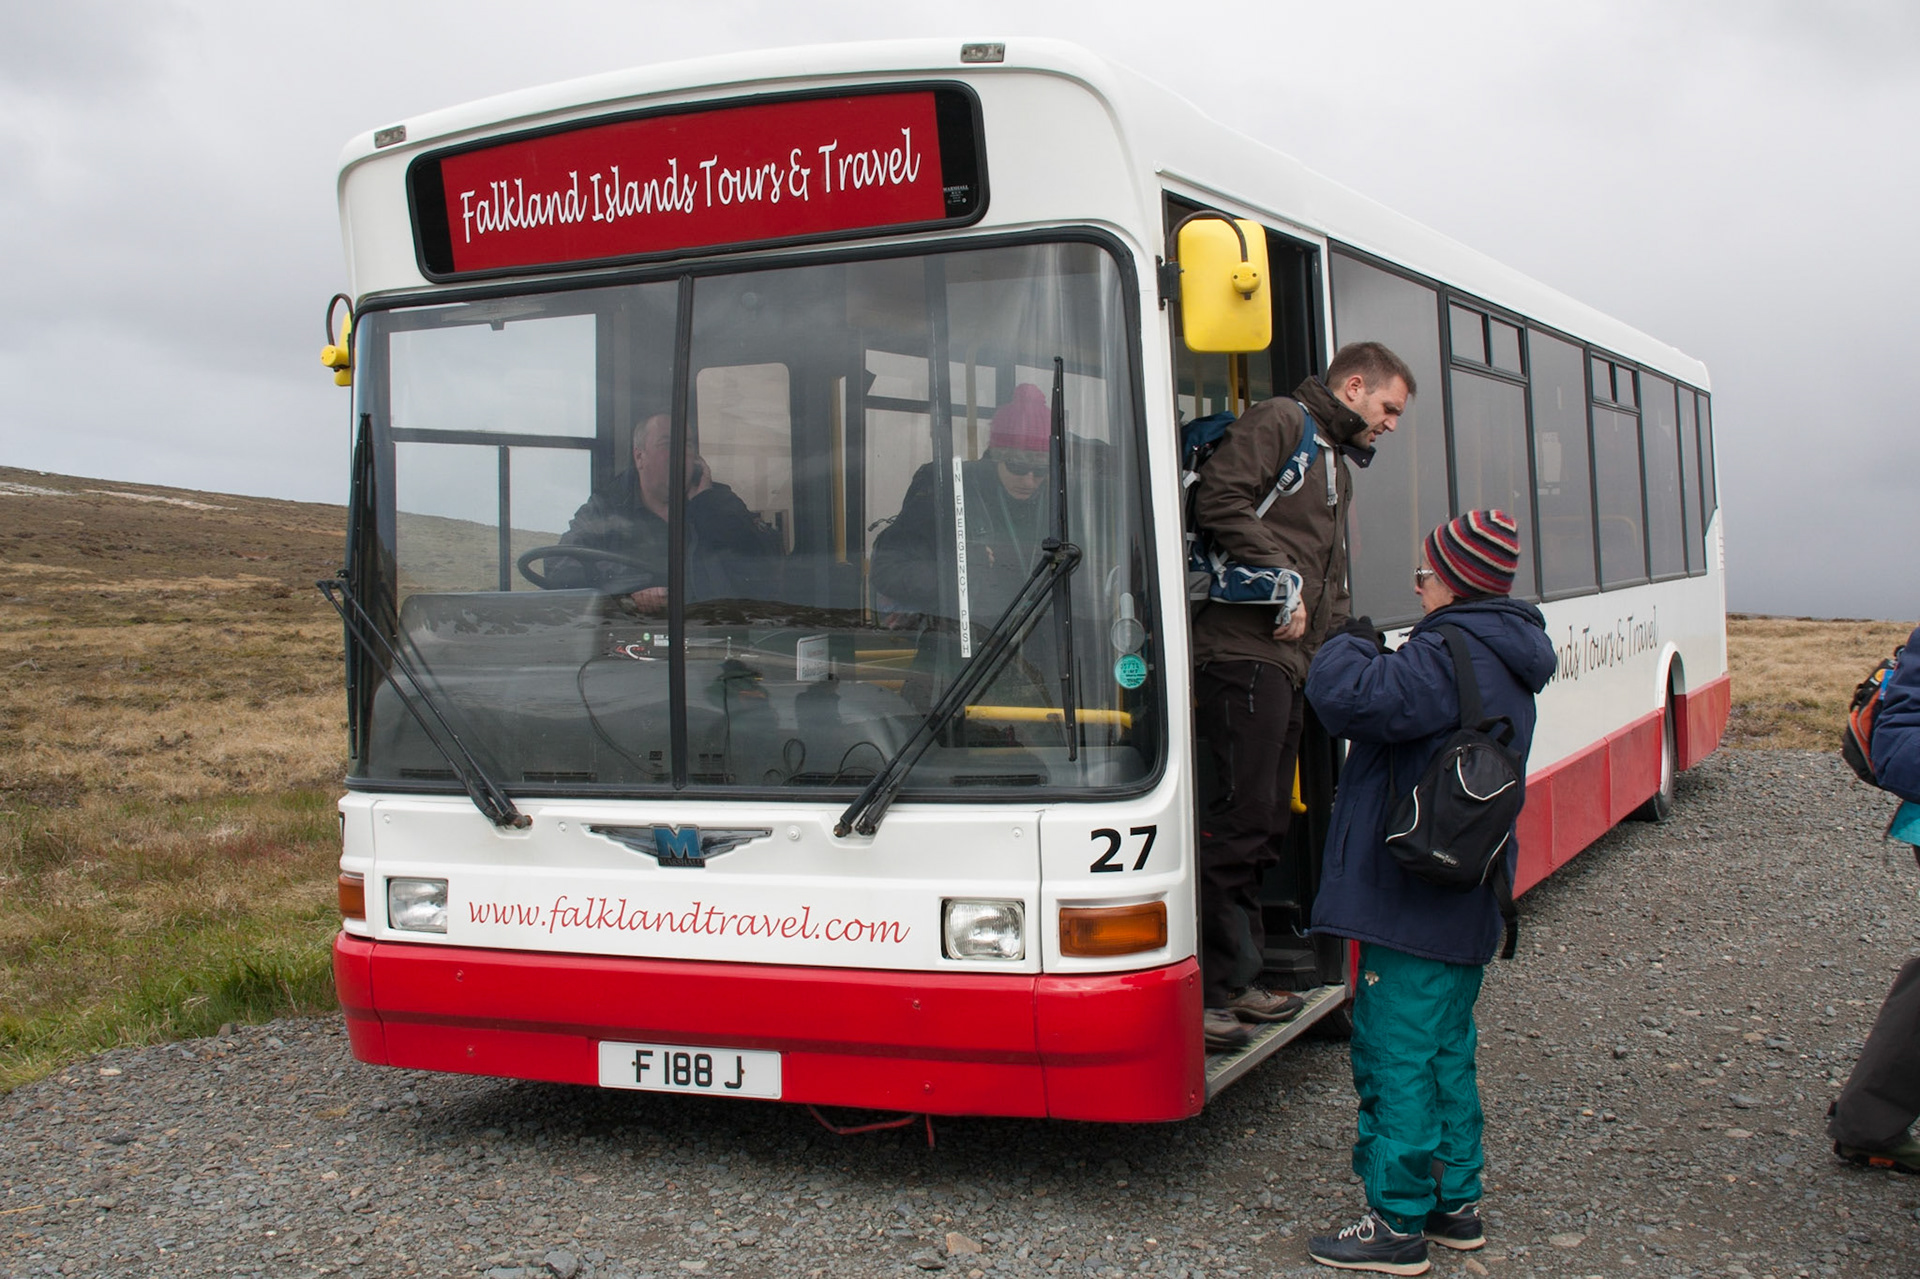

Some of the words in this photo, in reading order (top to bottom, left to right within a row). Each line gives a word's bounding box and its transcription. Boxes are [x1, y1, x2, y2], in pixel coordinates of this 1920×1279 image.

[460, 171, 588, 243] Falkland
[590, 158, 698, 223] Islands
[700, 154, 785, 207] Tours
[788, 148, 811, 202] &
[818, 127, 922, 193] Travel
[954, 461, 962, 483] IN
[956, 495, 966, 597] EMERGENCY
[961, 609, 970, 655] PUSH
[1582, 624, 1614, 674] Tours
[1627, 605, 1659, 658] Travel
[1089, 825, 1158, 873] 27
[469, 895, 910, 944] www.falklandtravel.com
[664, 1051, 713, 1088] 188
